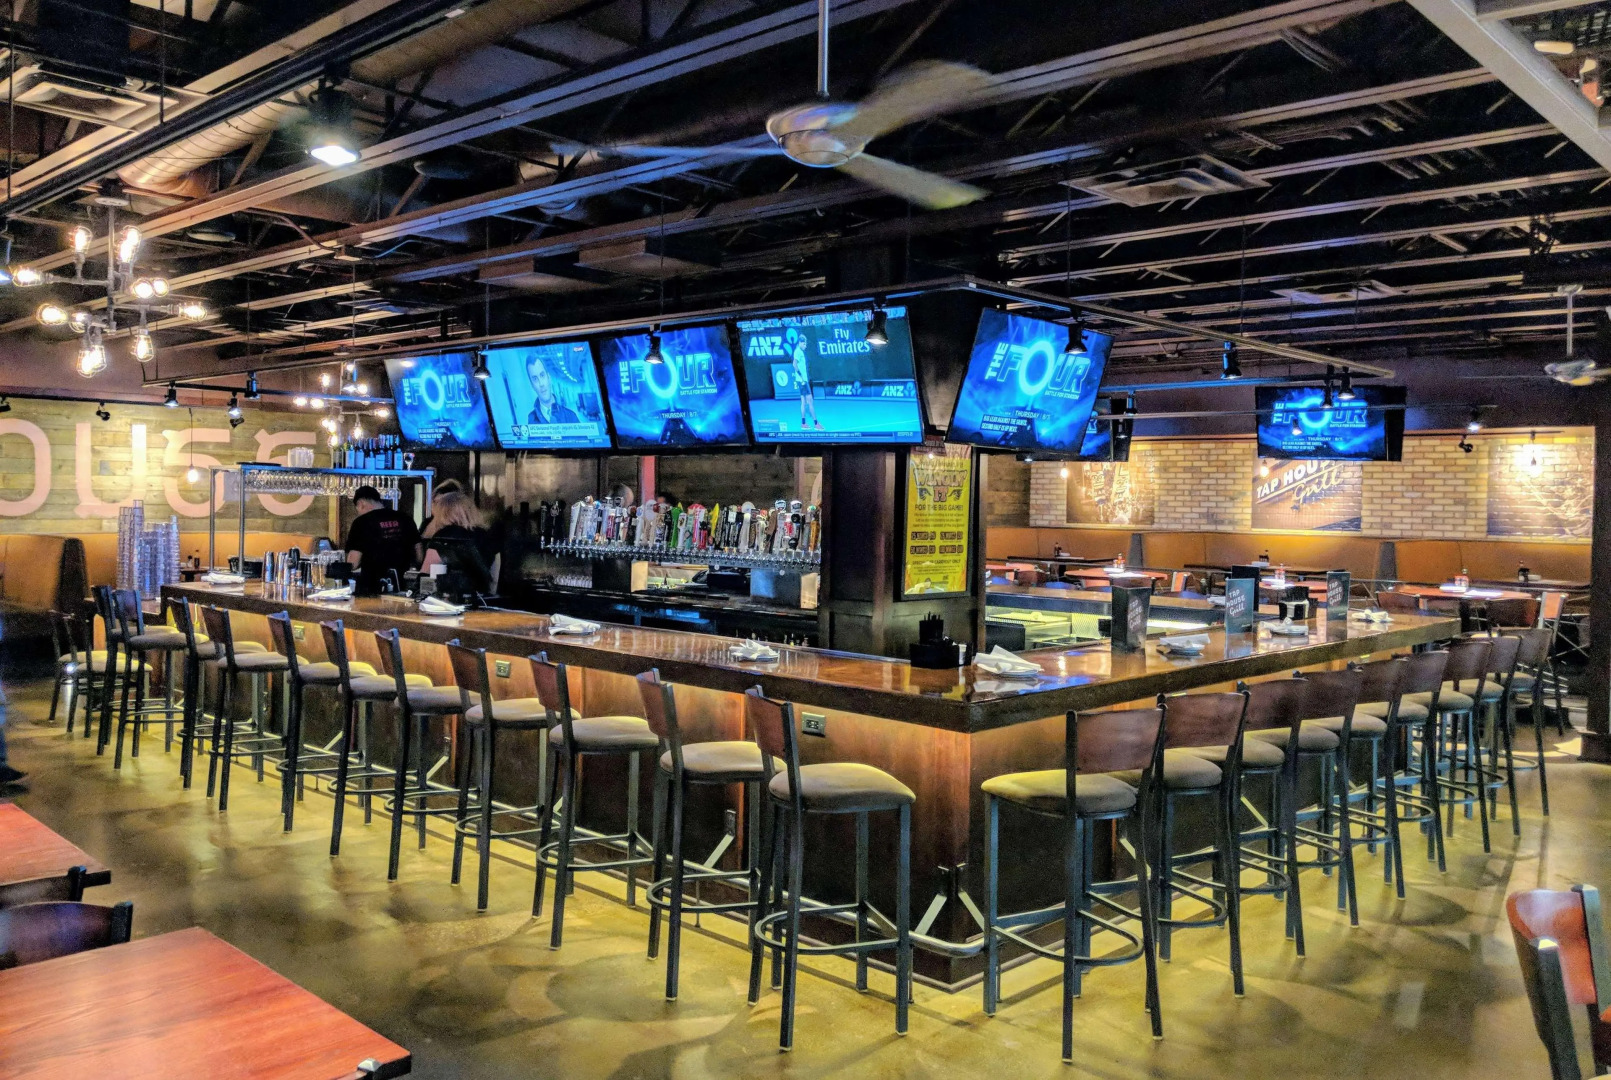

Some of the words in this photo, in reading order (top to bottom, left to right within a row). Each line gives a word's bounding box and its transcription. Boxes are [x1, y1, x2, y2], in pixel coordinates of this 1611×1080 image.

[834, 328, 849, 340] Fly
[748, 336, 784, 356] ANZ
[819, 340, 870, 355] Emirates
[984, 342, 1009, 380] THE
[997, 340, 1091, 396] FOUR
[619, 361, 631, 394] THE
[629, 350, 717, 399] FOUR
[402, 378, 412, 405] THE
[410, 369, 471, 411] FOUR
[835, 385, 852, 395] ANZ
[881, 385, 904, 397] ANZ
[662, 411, 686, 419] THURSDAY
[1015, 410, 1039, 419] THURSDAY
[1256, 477, 1279, 499] TAP
[1292, 469, 1343, 504] Grill
[1329, 581, 1338, 589] TAP
[1226, 594, 1246, 608] HOUSE
[1229, 589, 1240, 598] TAP
[1230, 602, 1244, 616] Grill
